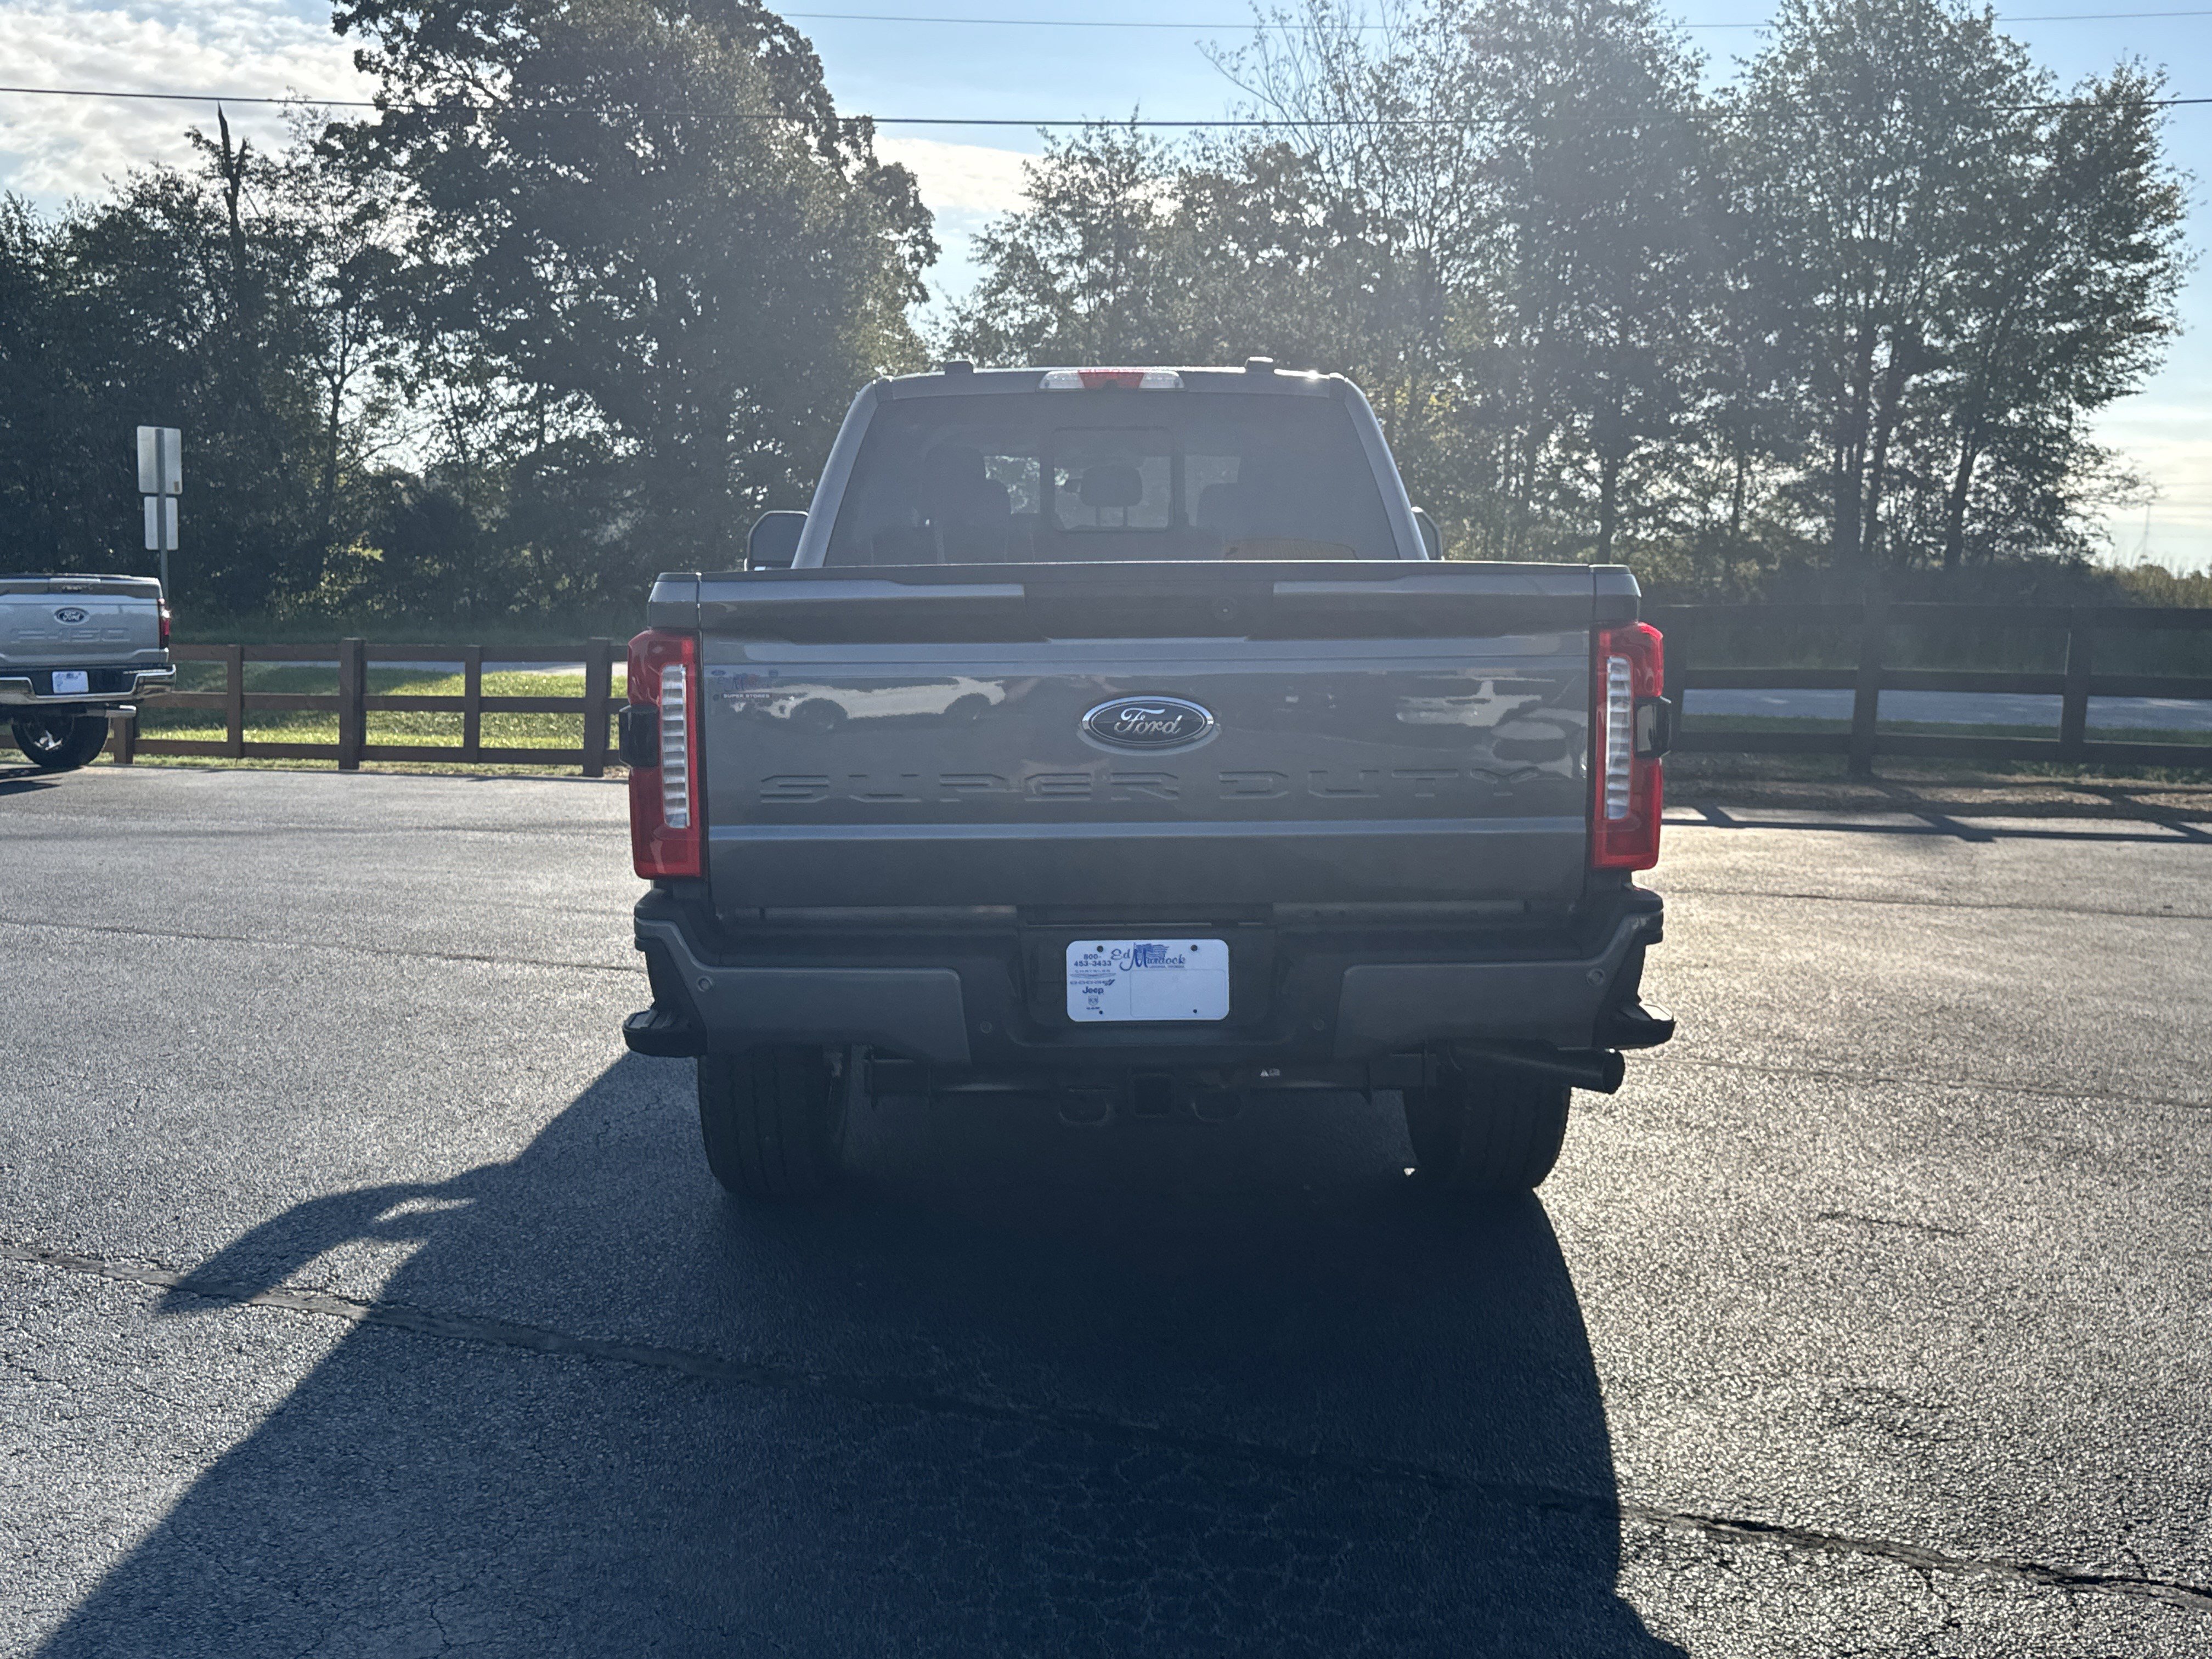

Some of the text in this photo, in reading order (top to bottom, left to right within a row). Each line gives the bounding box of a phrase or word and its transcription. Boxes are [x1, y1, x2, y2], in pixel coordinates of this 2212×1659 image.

[1114, 707, 1183, 734] Ford
[760, 766, 1538, 803] SUPER DUTY
[1110, 949, 1130, 960] Ed
[1082, 986, 1104, 995] Jeep
